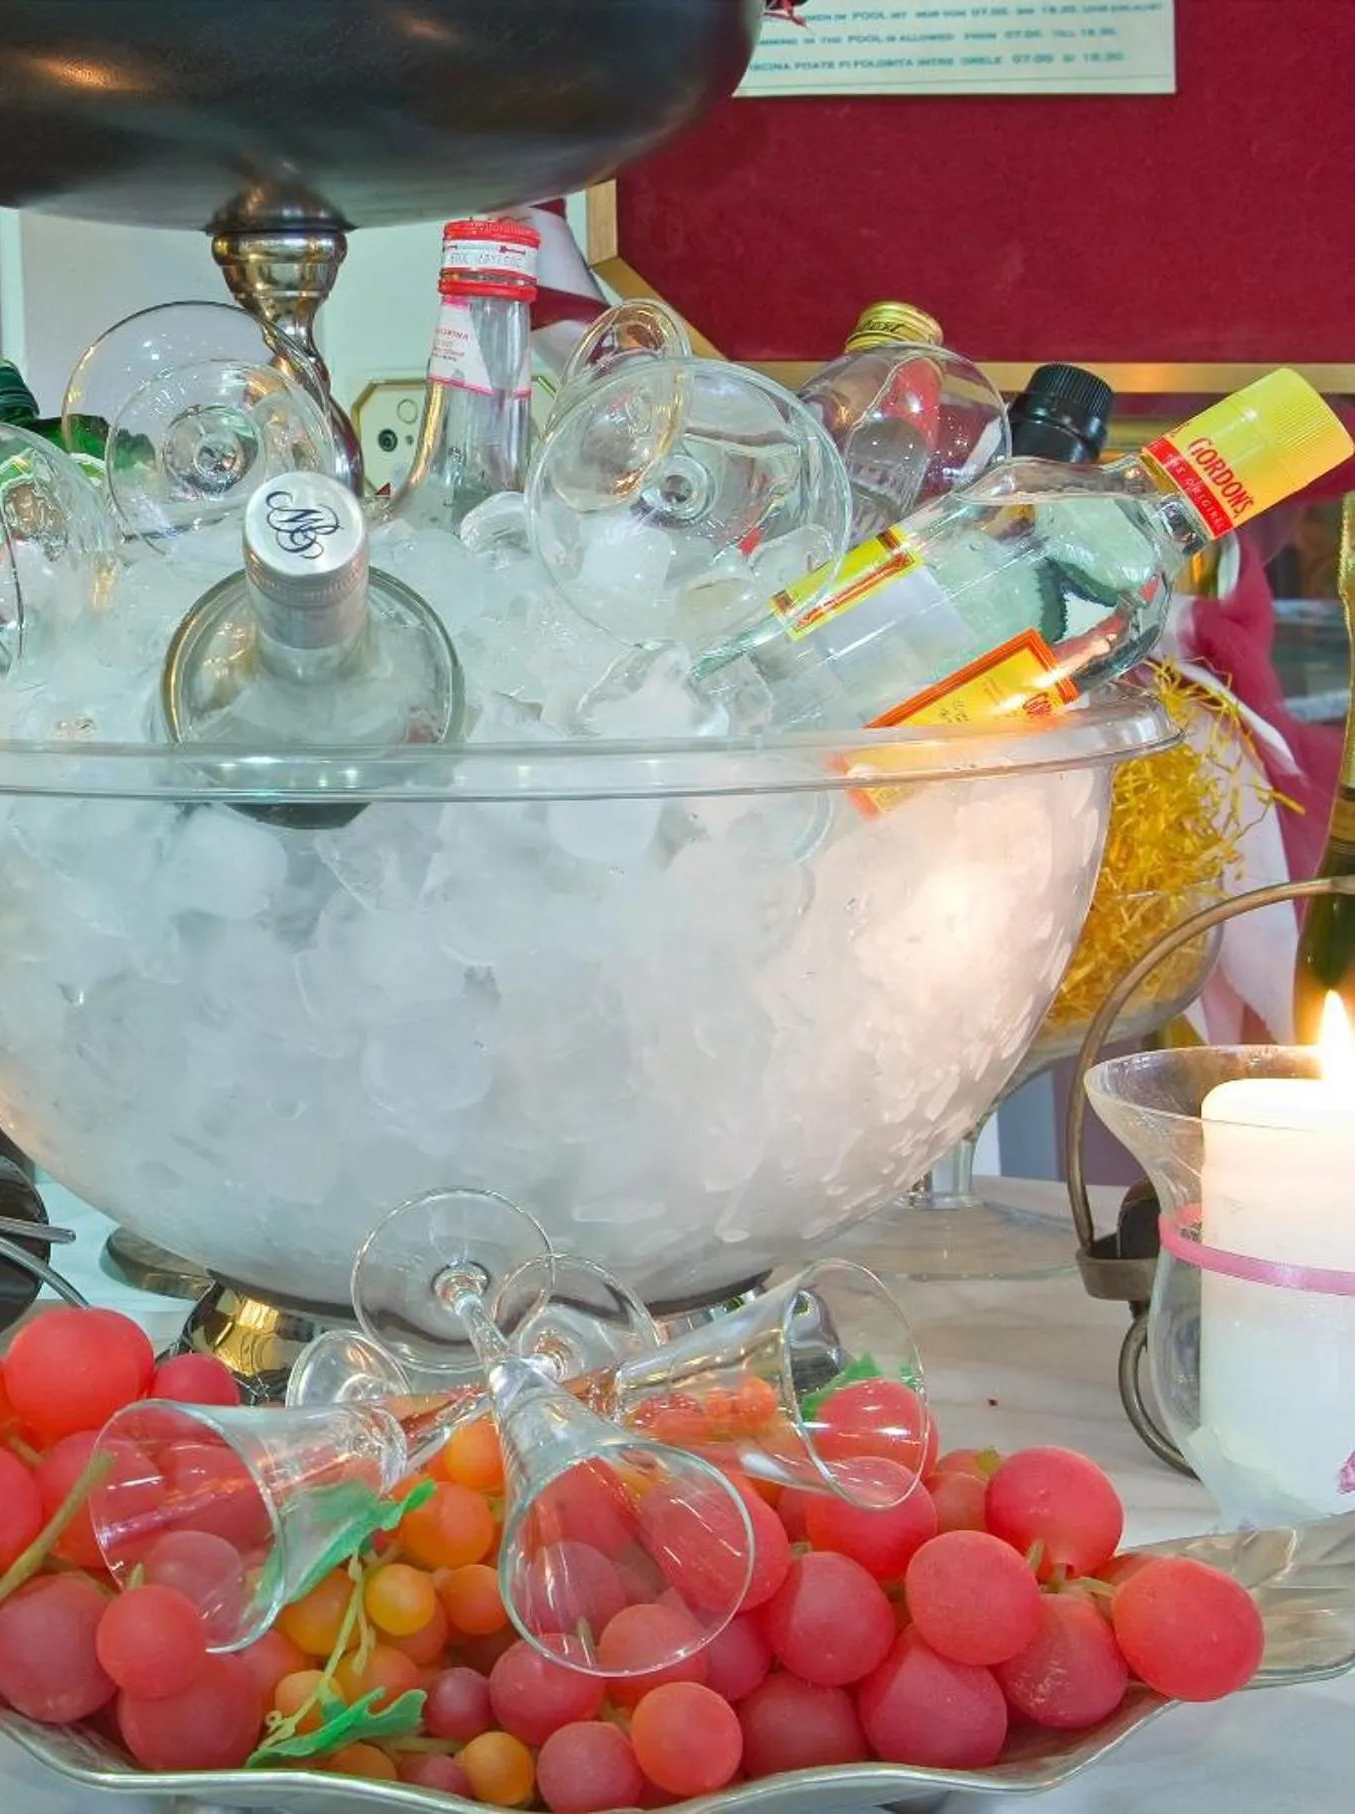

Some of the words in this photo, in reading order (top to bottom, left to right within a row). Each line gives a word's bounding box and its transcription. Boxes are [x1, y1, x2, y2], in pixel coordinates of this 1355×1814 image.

[852, 12, 886, 21] POOL
[821, 36, 843, 44] THE
[848, 35, 882, 44] POOL
